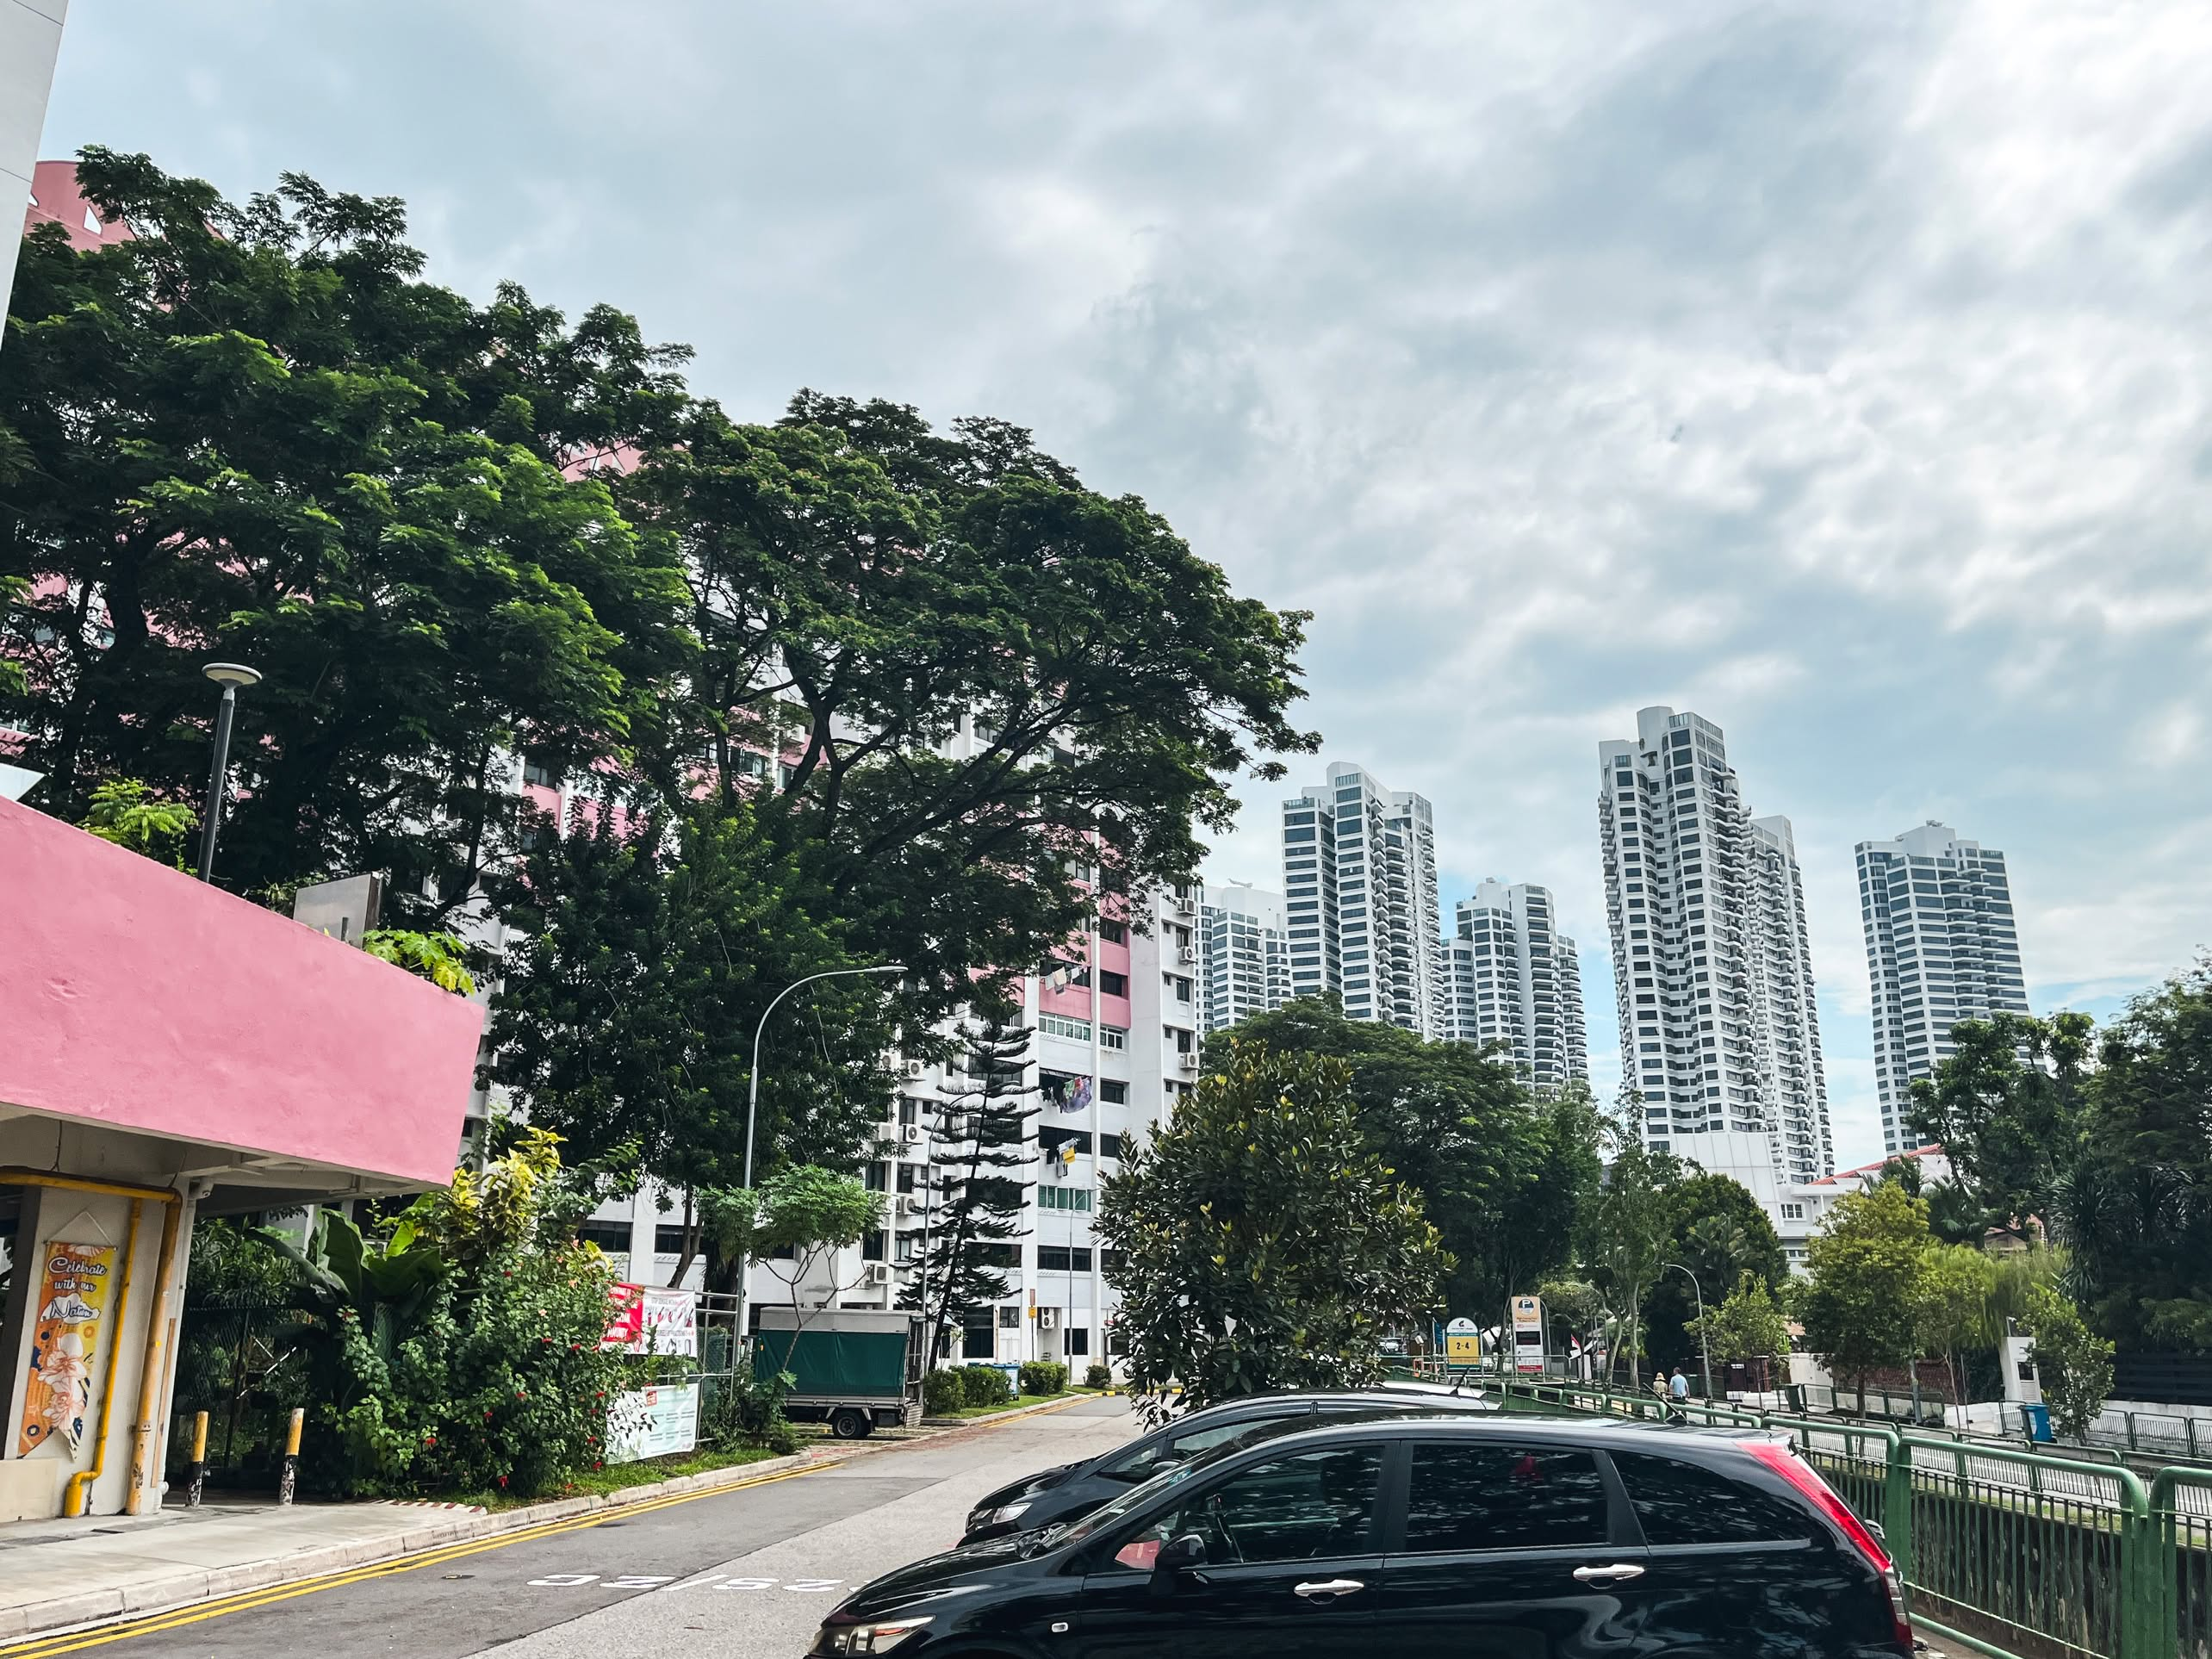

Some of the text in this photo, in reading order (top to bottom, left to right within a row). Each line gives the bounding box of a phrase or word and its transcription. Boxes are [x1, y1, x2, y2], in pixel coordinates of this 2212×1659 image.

[48, 1257, 106, 1275] Celebrate
[53, 1277, 96, 1292] with our
[49, 1299, 93, 1319] Nation
[1522, 1299, 1531, 1309] P
